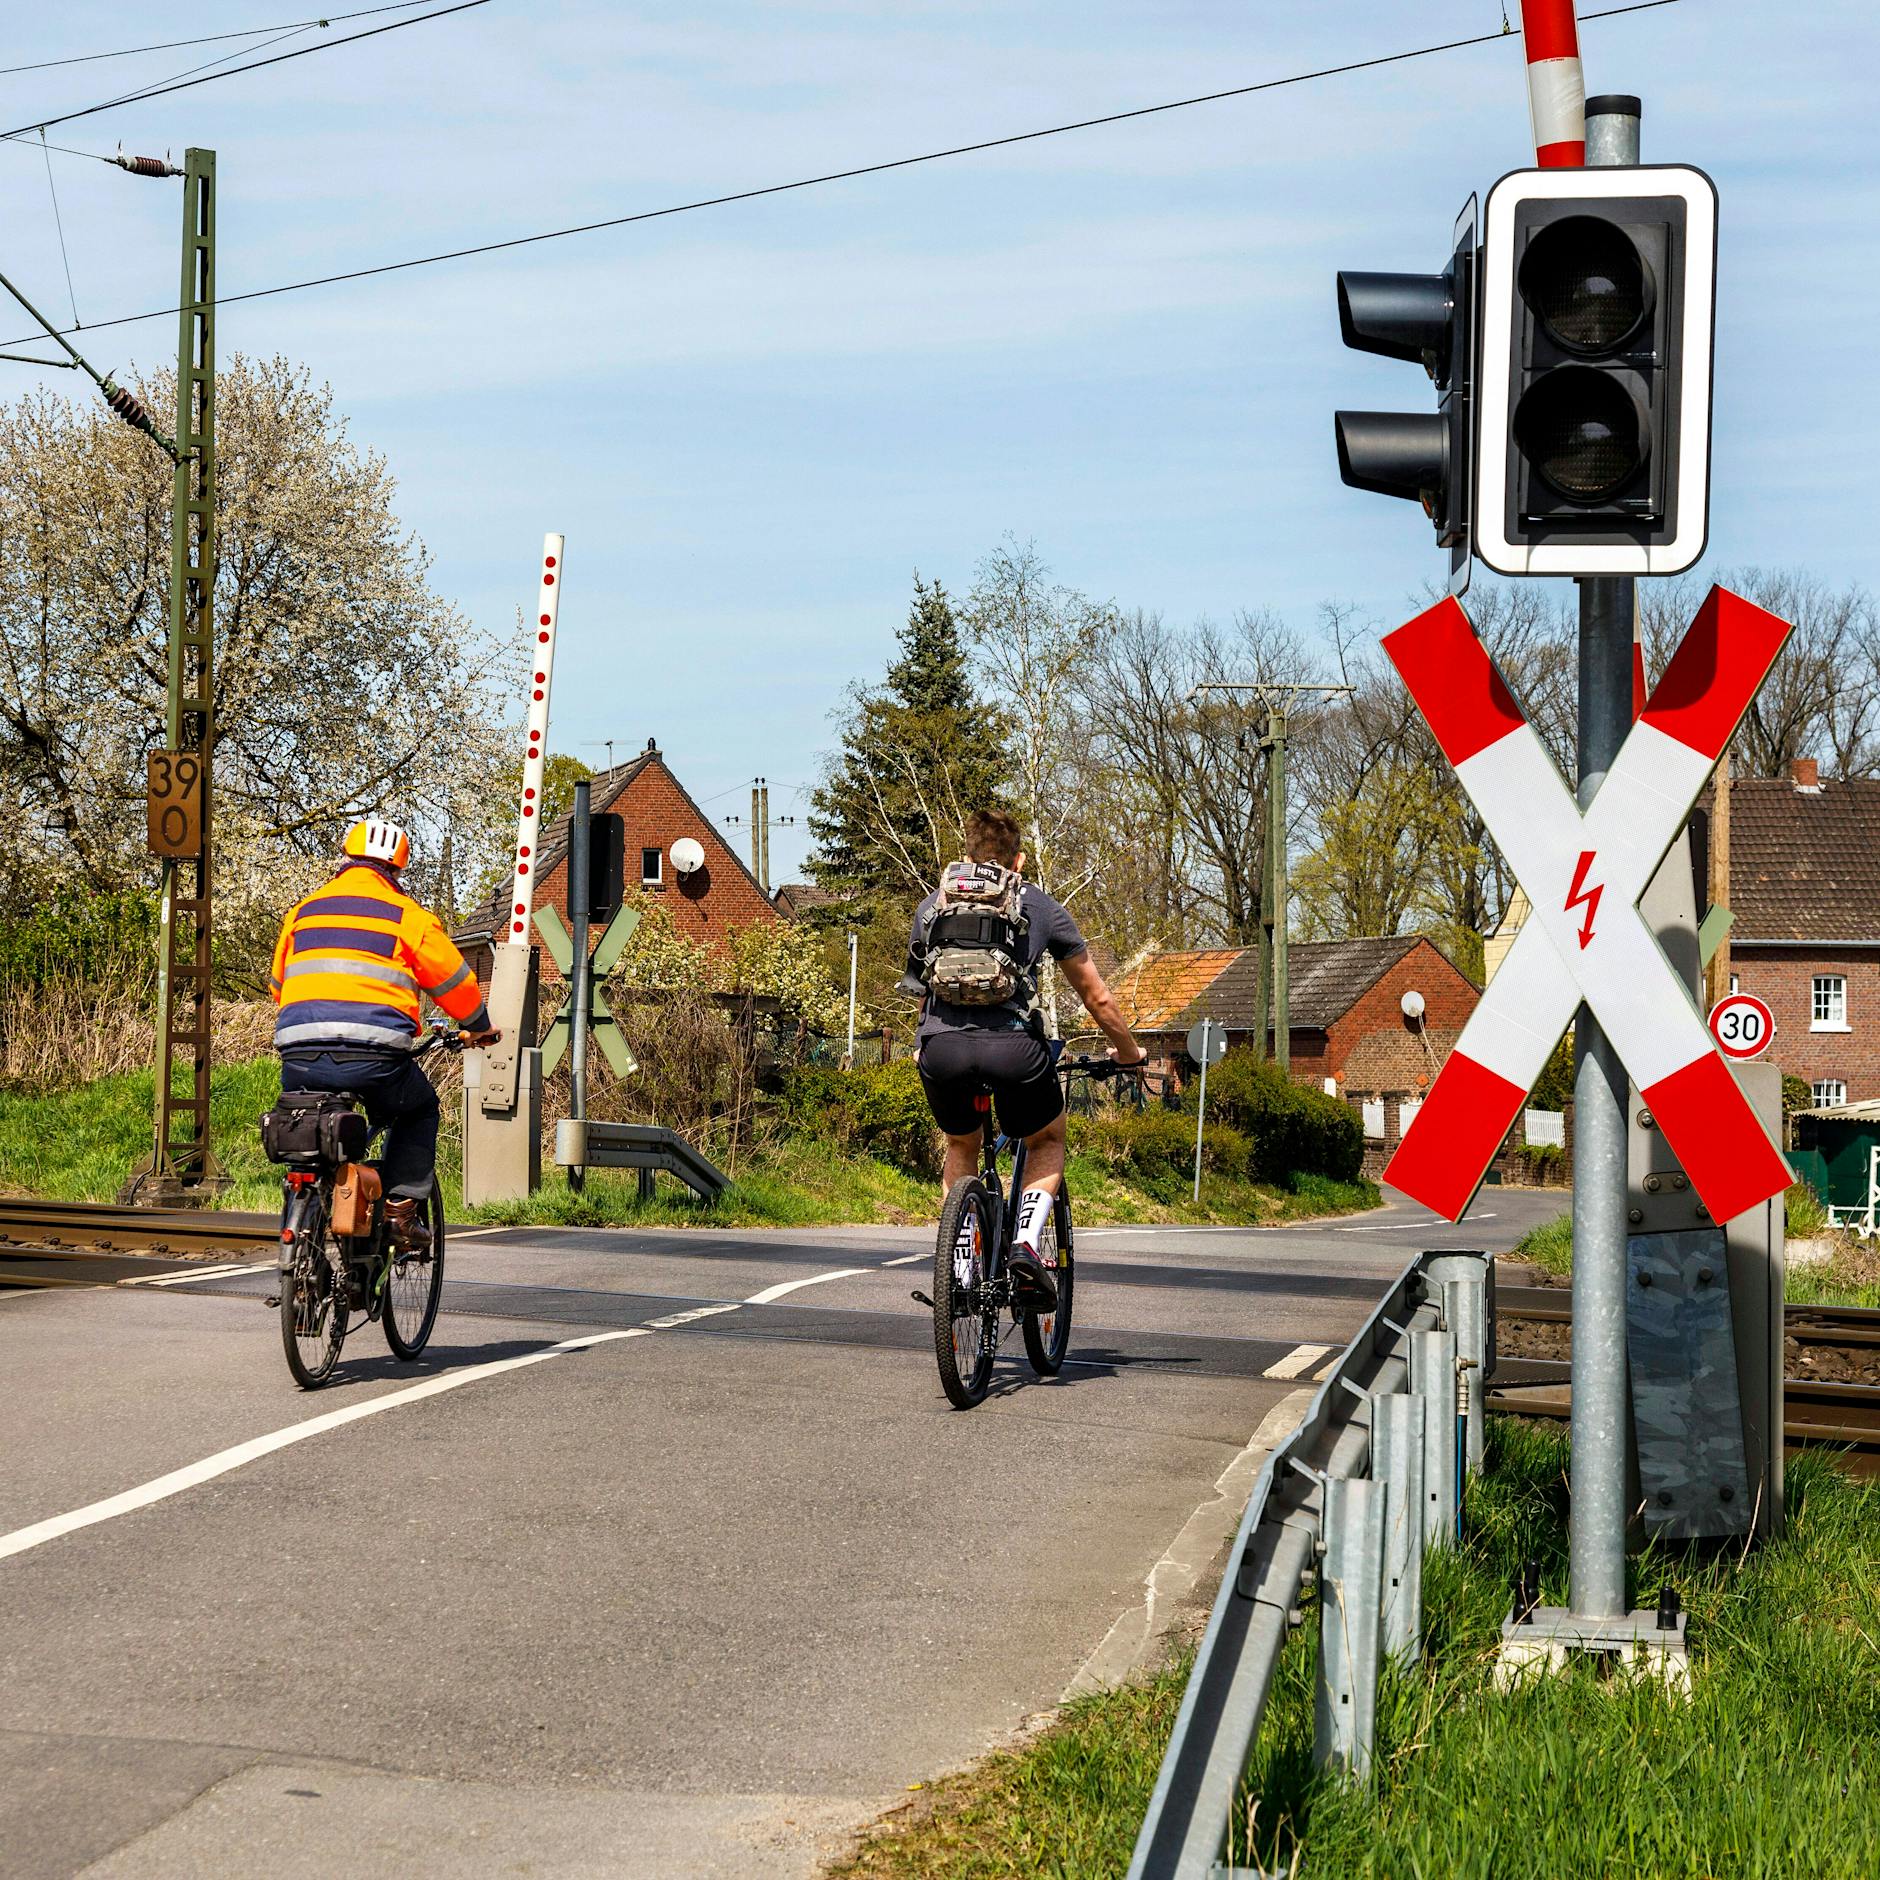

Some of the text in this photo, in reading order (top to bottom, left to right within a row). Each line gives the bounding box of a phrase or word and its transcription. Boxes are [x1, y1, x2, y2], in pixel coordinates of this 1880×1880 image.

[152, 757, 198, 799] 39
[161, 805, 188, 847] 0
[1723, 1012, 1759, 1041] 30
